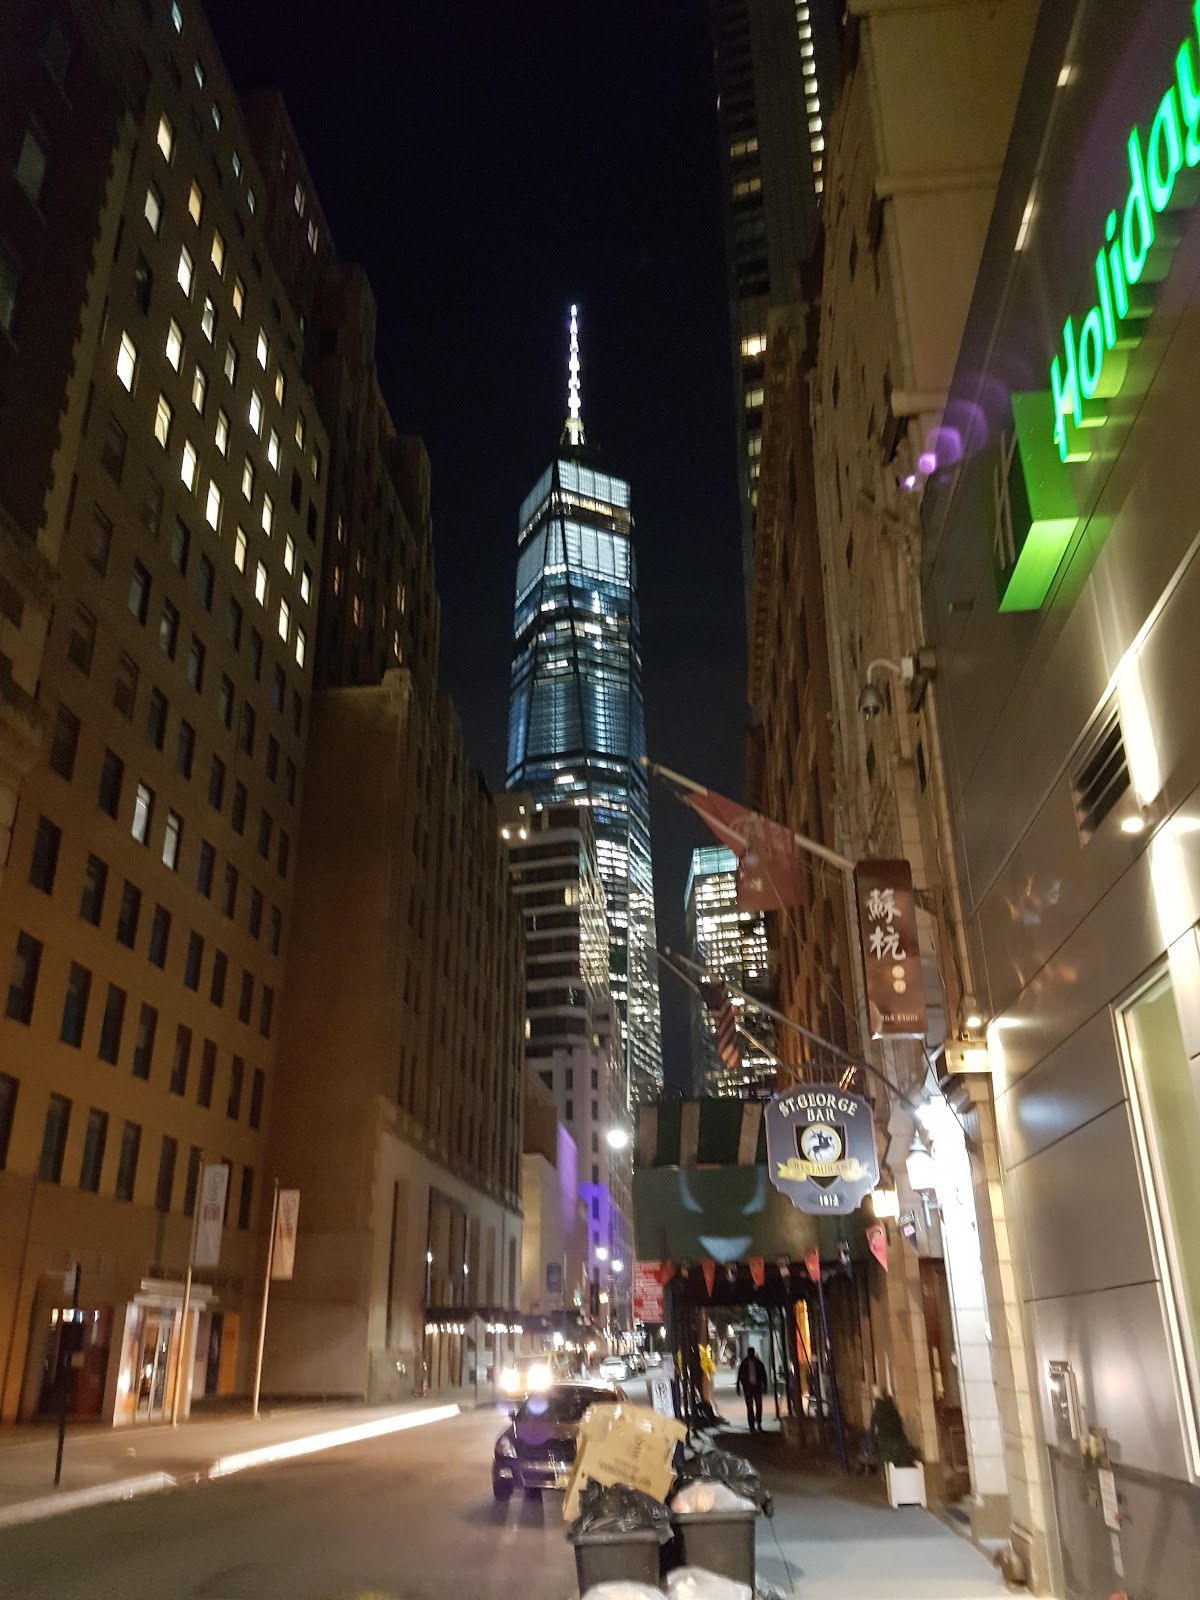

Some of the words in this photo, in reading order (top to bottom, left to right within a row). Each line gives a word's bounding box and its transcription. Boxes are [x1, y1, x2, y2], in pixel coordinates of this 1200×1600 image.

[1050, 0, 1200, 465] Holiday
[798, 1092, 858, 1117] GEORGE
[807, 1107, 836, 1122] BAR
